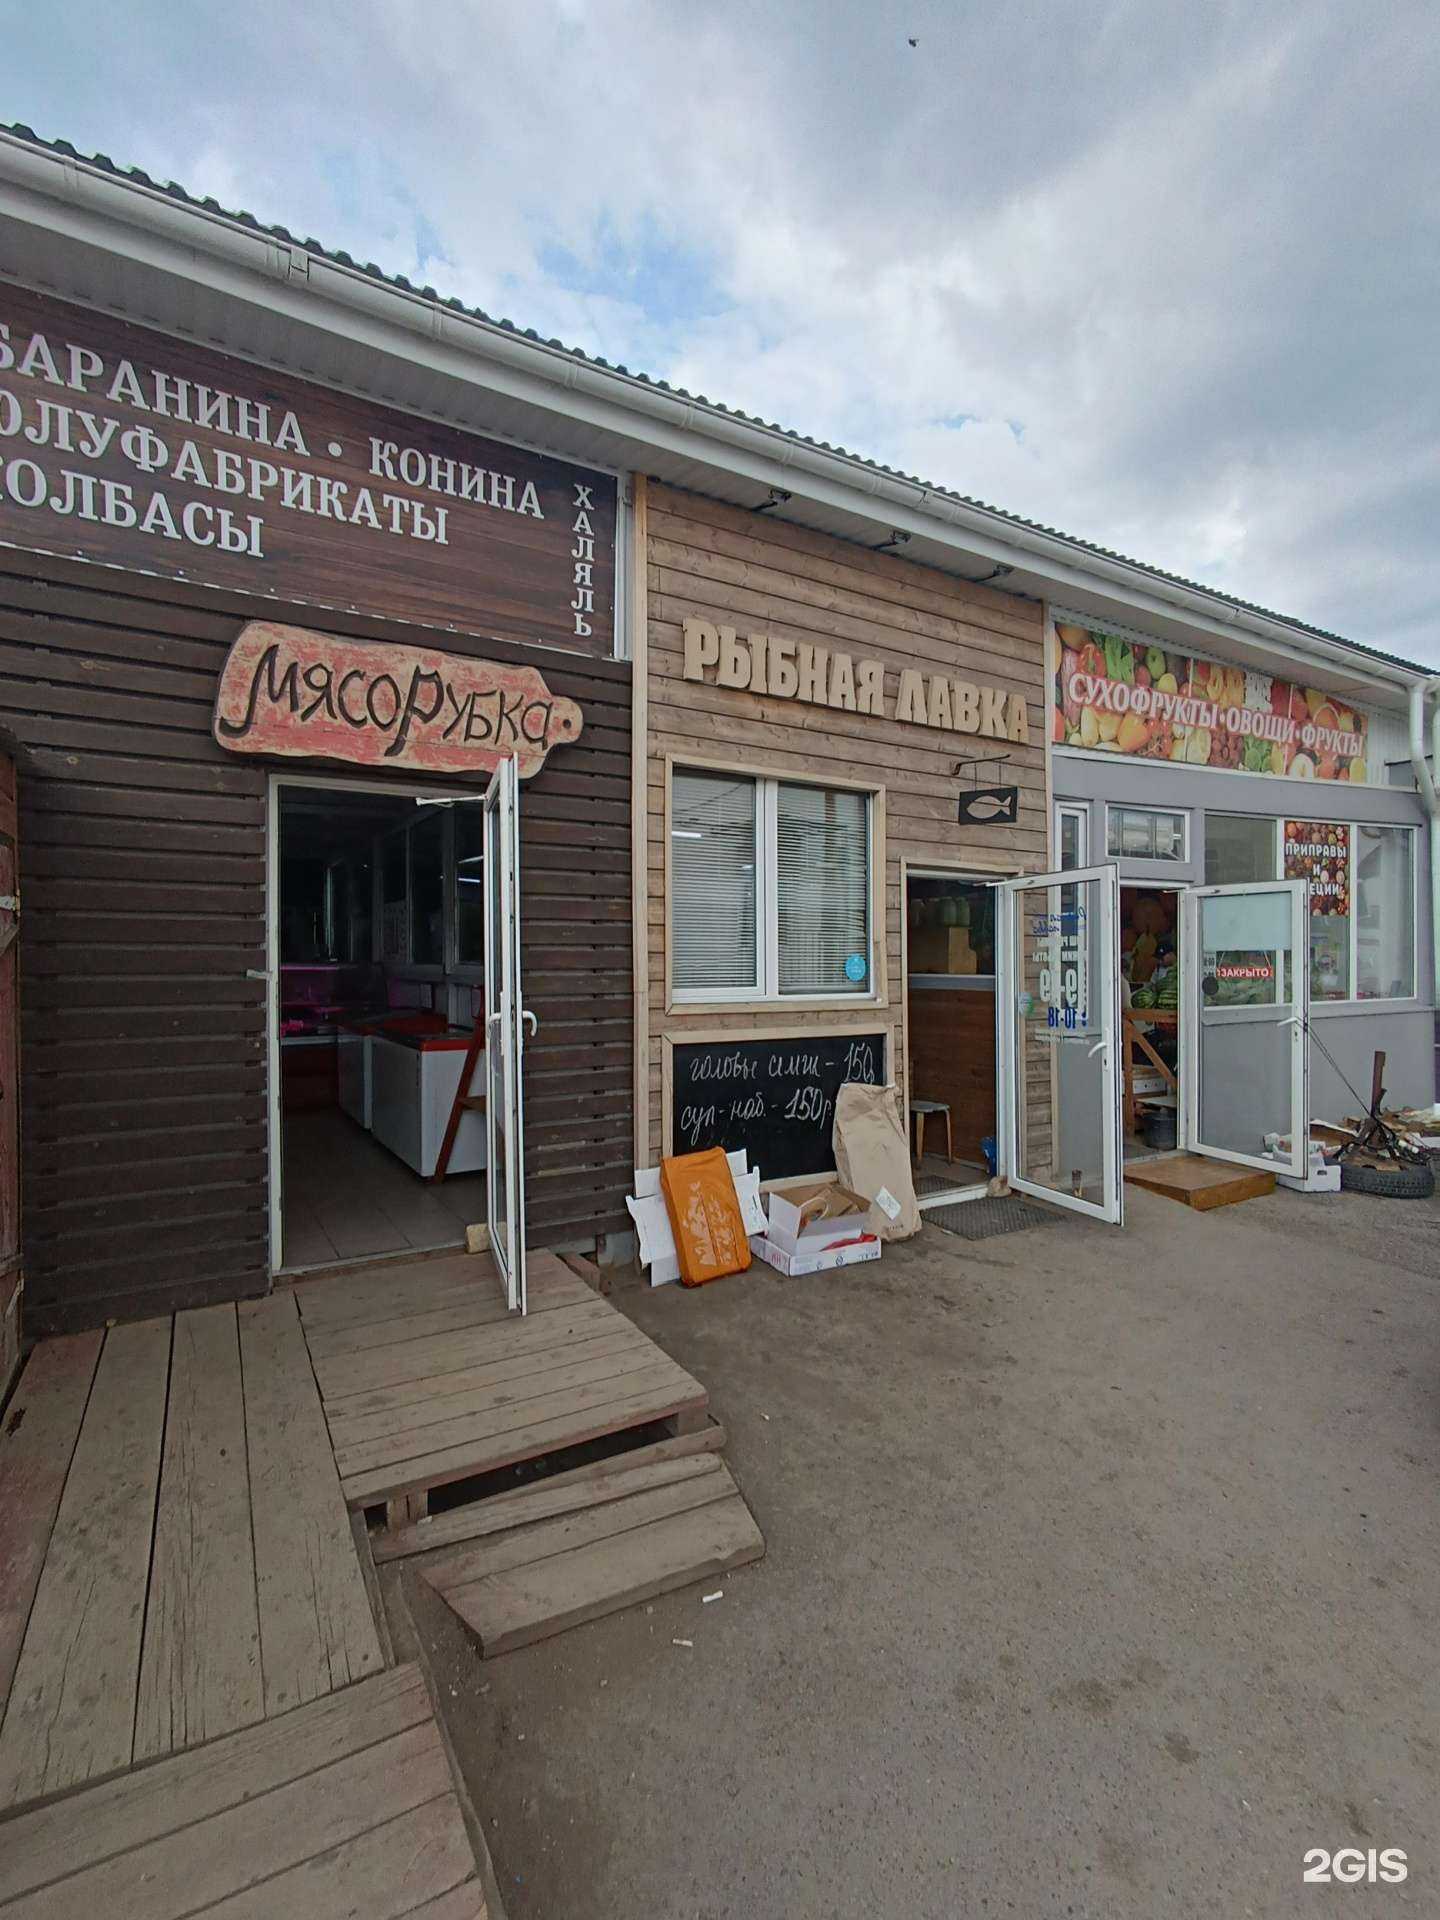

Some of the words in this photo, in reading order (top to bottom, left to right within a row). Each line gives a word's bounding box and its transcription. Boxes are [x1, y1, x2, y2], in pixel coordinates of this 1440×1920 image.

[0, 456, 265, 558] ОЛБАСЫ
[369, 437, 545, 520] КОНИНА
[571, 483, 596, 637] ХАЛЯЛЬ
[682, 617, 886, 717] РЫБНАЯ
[895, 668, 1030, 744] ЛАВКА
[1068, 672, 1218, 729] СУХОФРУКТЫ
[1226, 707, 1295, 743] ОВОЩИ
[1301, 722, 1364, 757] ФРУКТЫ
[1285, 843, 1346, 858] ПРИПРАВЫ
[1309, 883, 1339, 896] ЕЦИИ
[1313, 864, 1320, 876] И
[1221, 967, 1269, 978] ЗАКРЫТО
